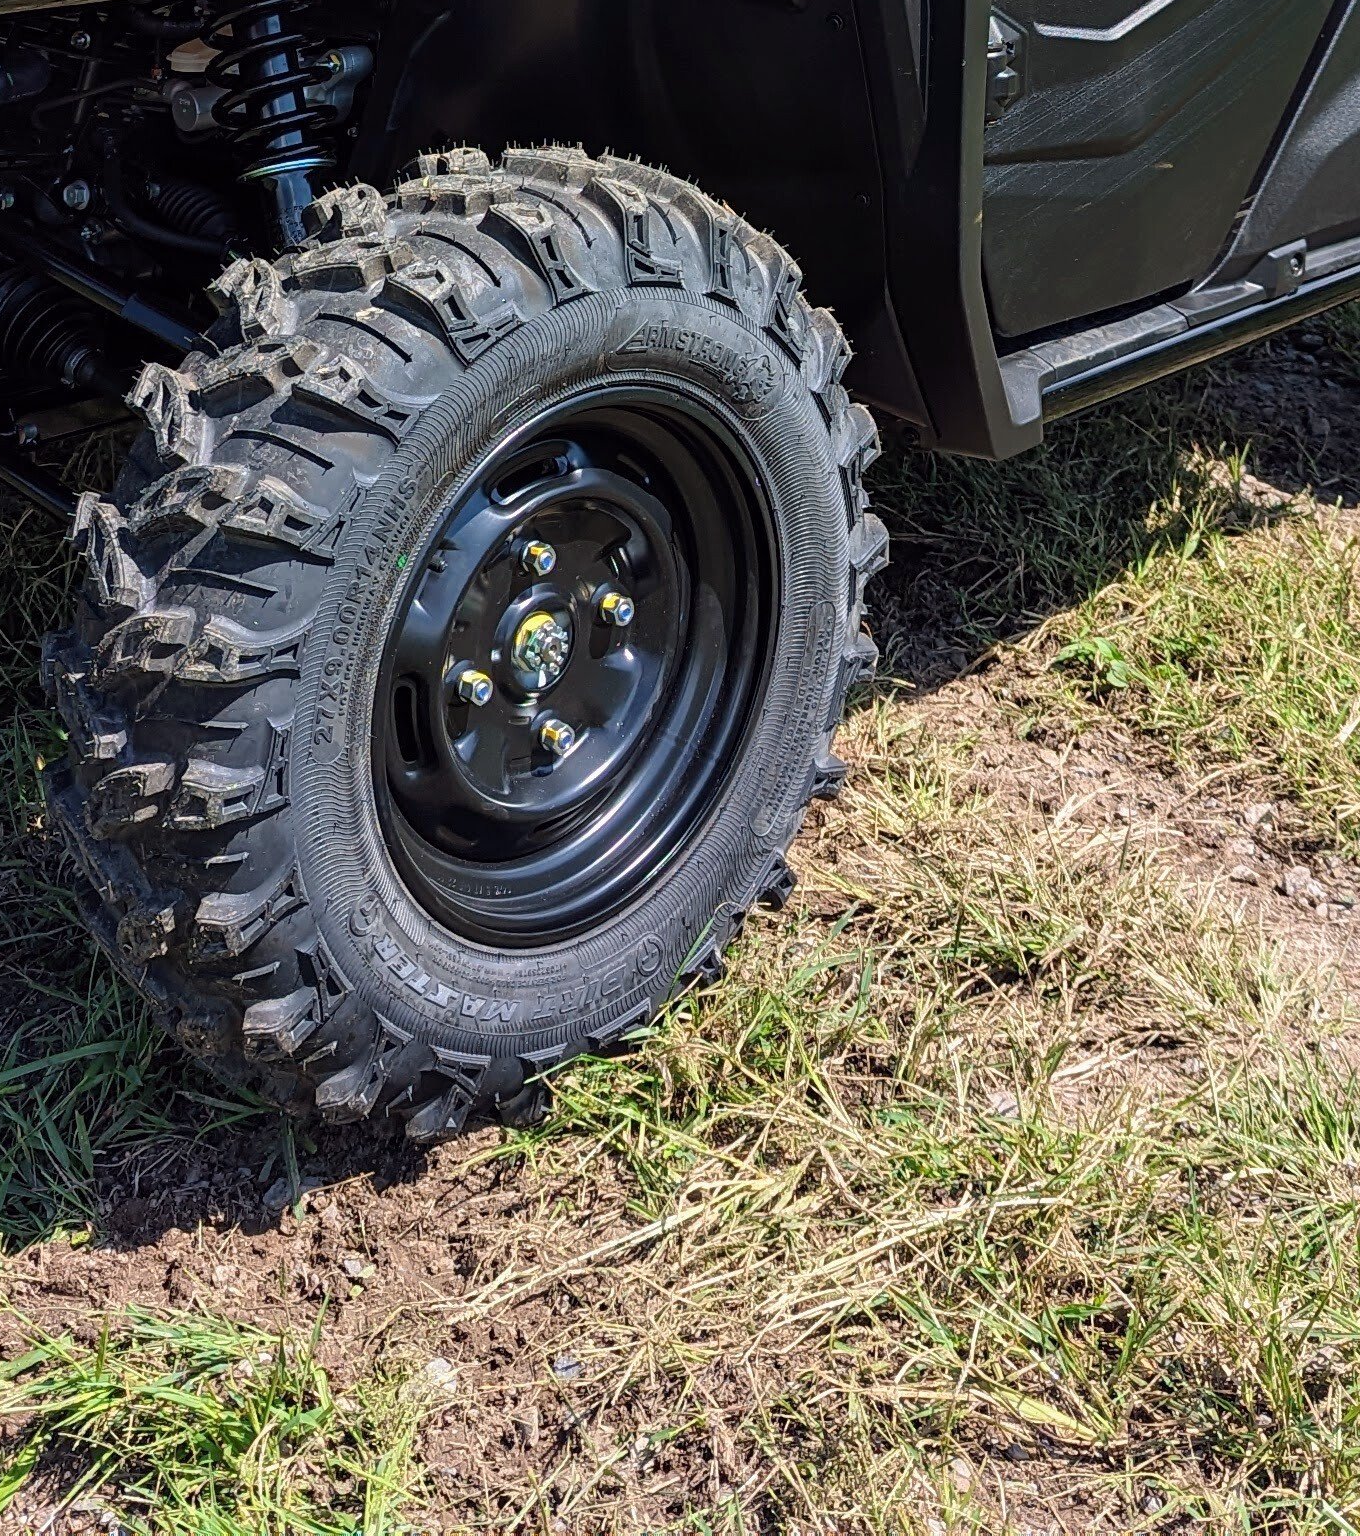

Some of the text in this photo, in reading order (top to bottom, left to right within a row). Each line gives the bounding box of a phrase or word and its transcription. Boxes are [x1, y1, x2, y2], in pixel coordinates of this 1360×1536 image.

[616, 319, 747, 373] ARMSTRONG
[374, 936, 522, 1023] MASTER
[531, 963, 627, 1021] DIRT
